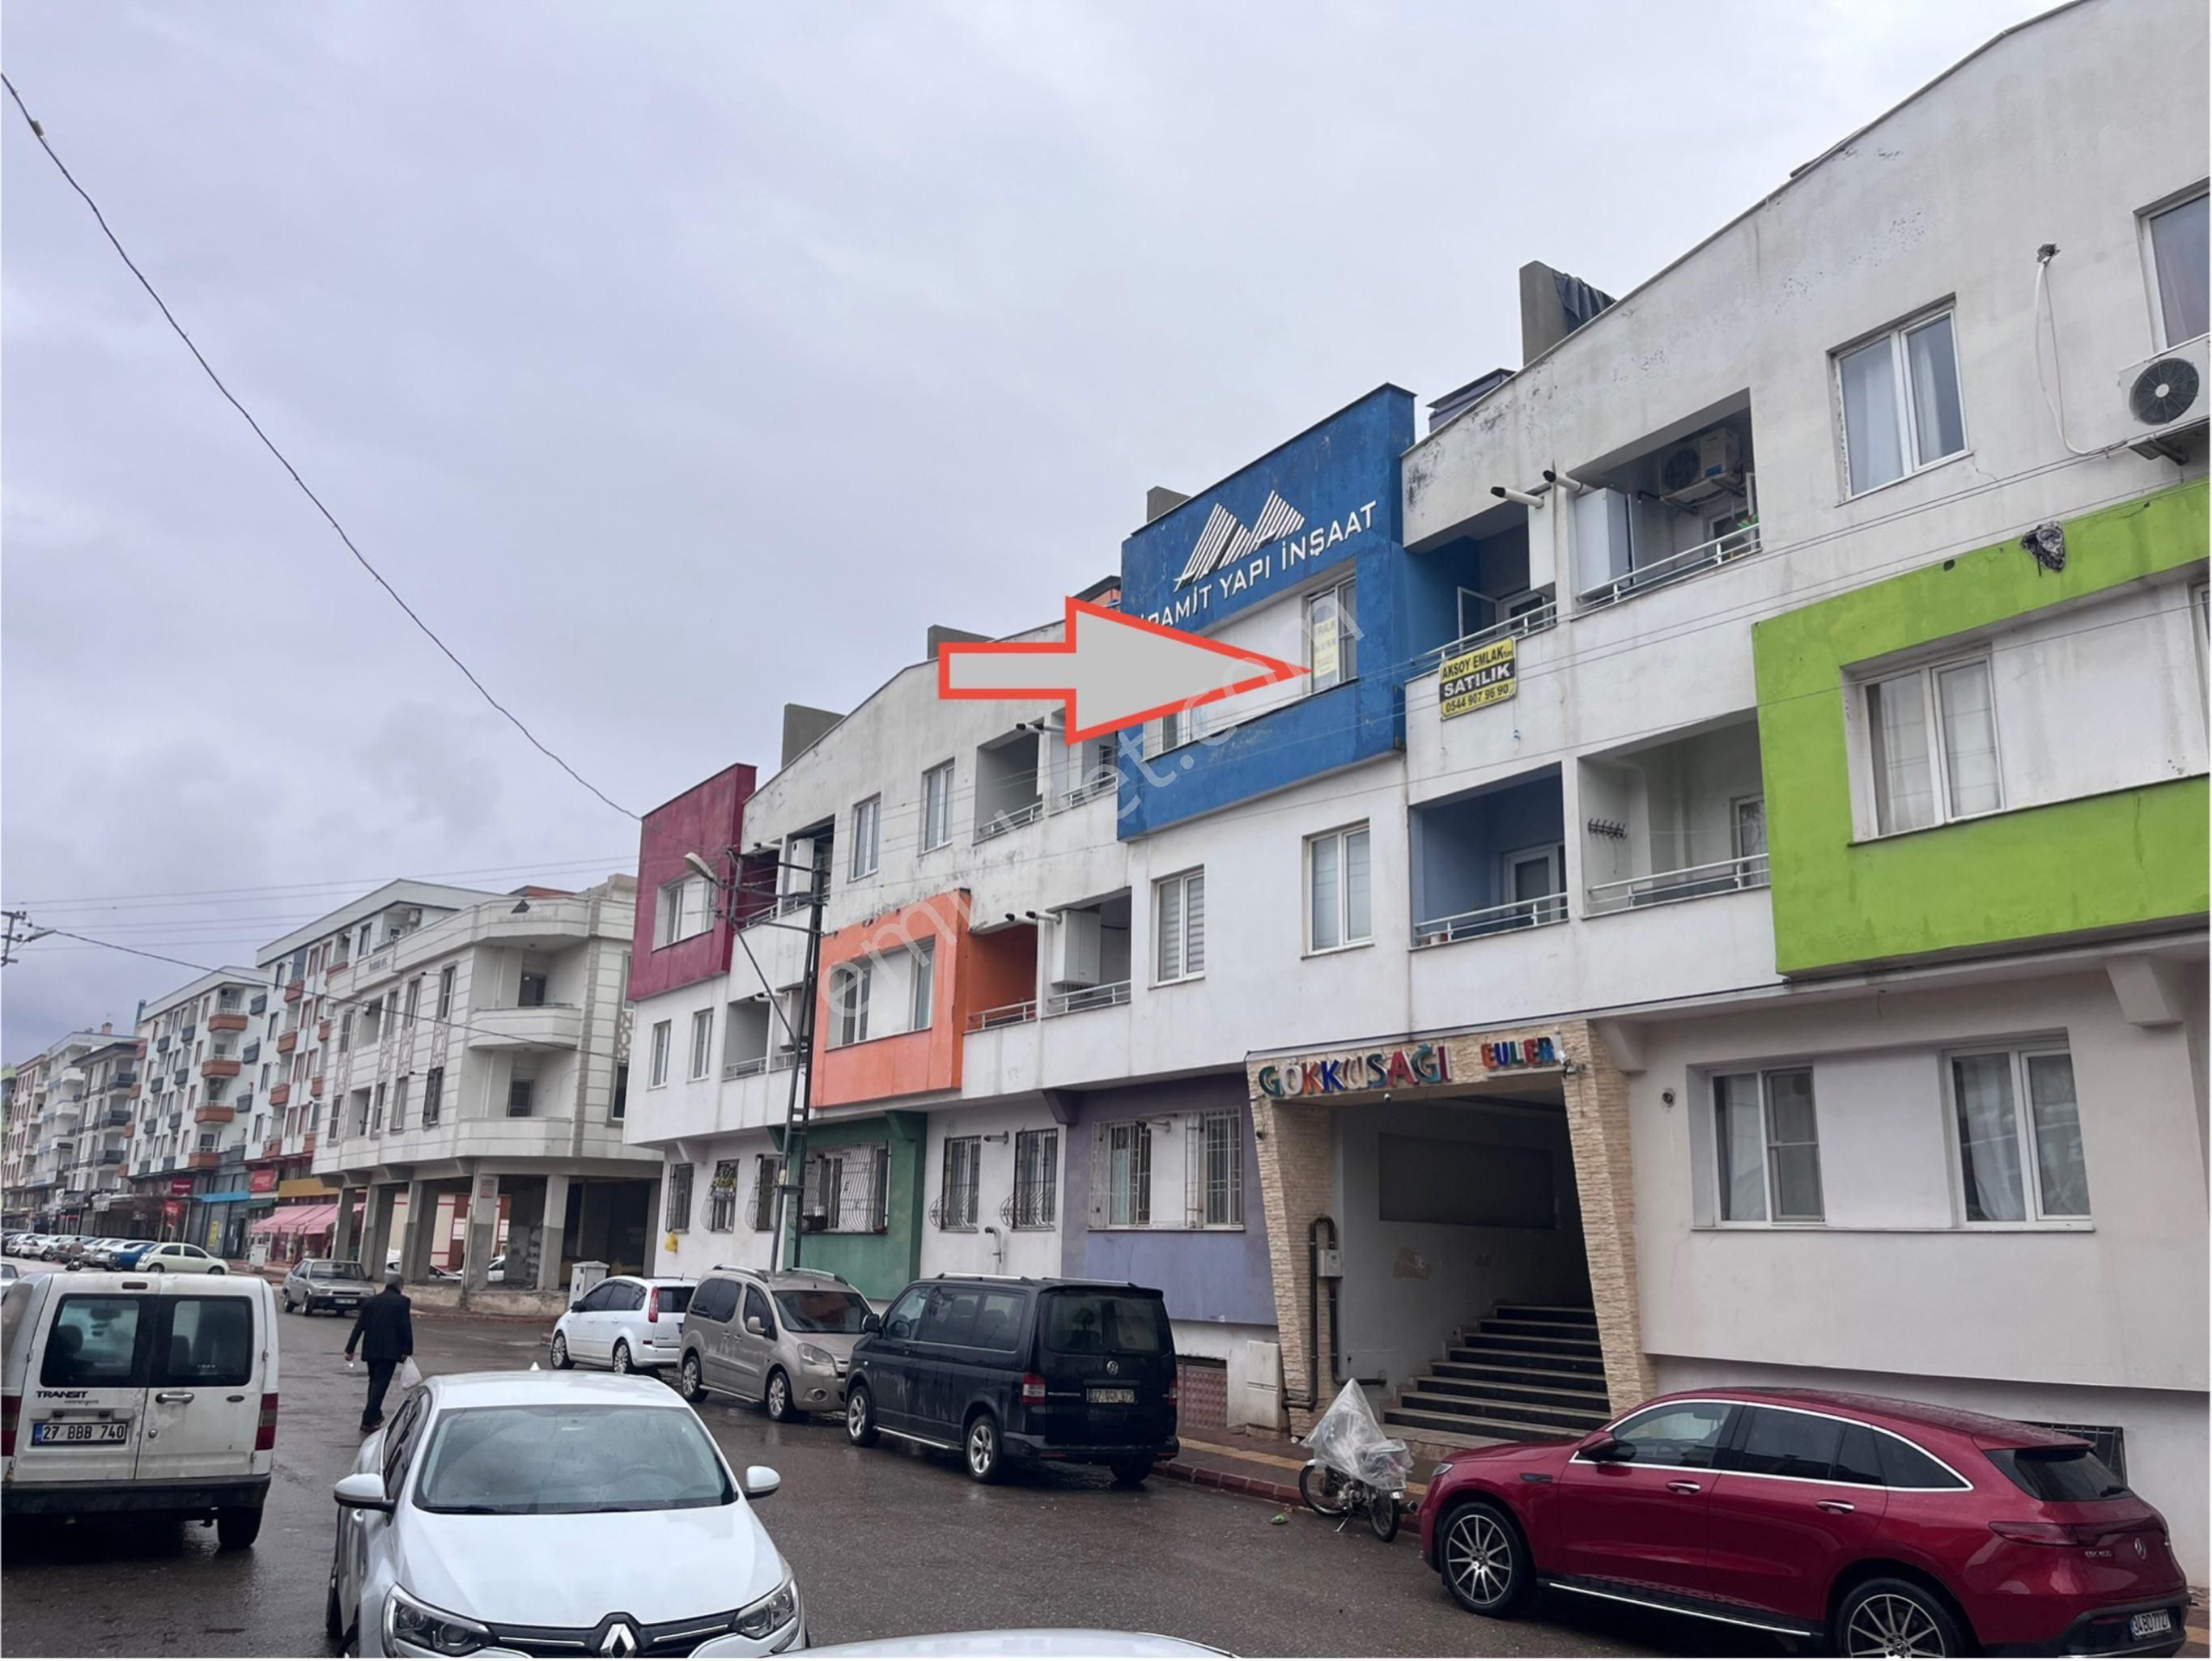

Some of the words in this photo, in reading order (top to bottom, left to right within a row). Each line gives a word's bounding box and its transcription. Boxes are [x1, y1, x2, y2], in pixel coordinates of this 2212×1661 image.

[1140, 584, 1212, 626] AMİT
[1220, 555, 1270, 599] YAPI
[1281, 500, 1377, 571] İNŞAAT
[1442, 658, 1471, 679] AKSOY
[1444, 663, 1510, 697] SATILIK
[1446, 697, 1467, 713] 0544
[1497, 683, 1509, 696] 90
[36, 1391, 88, 1399] TRANSIT
[43, 1425, 60, 1440] 27
[67, 1425, 92, 1439] BBB
[100, 1425, 125, 1439] 740
